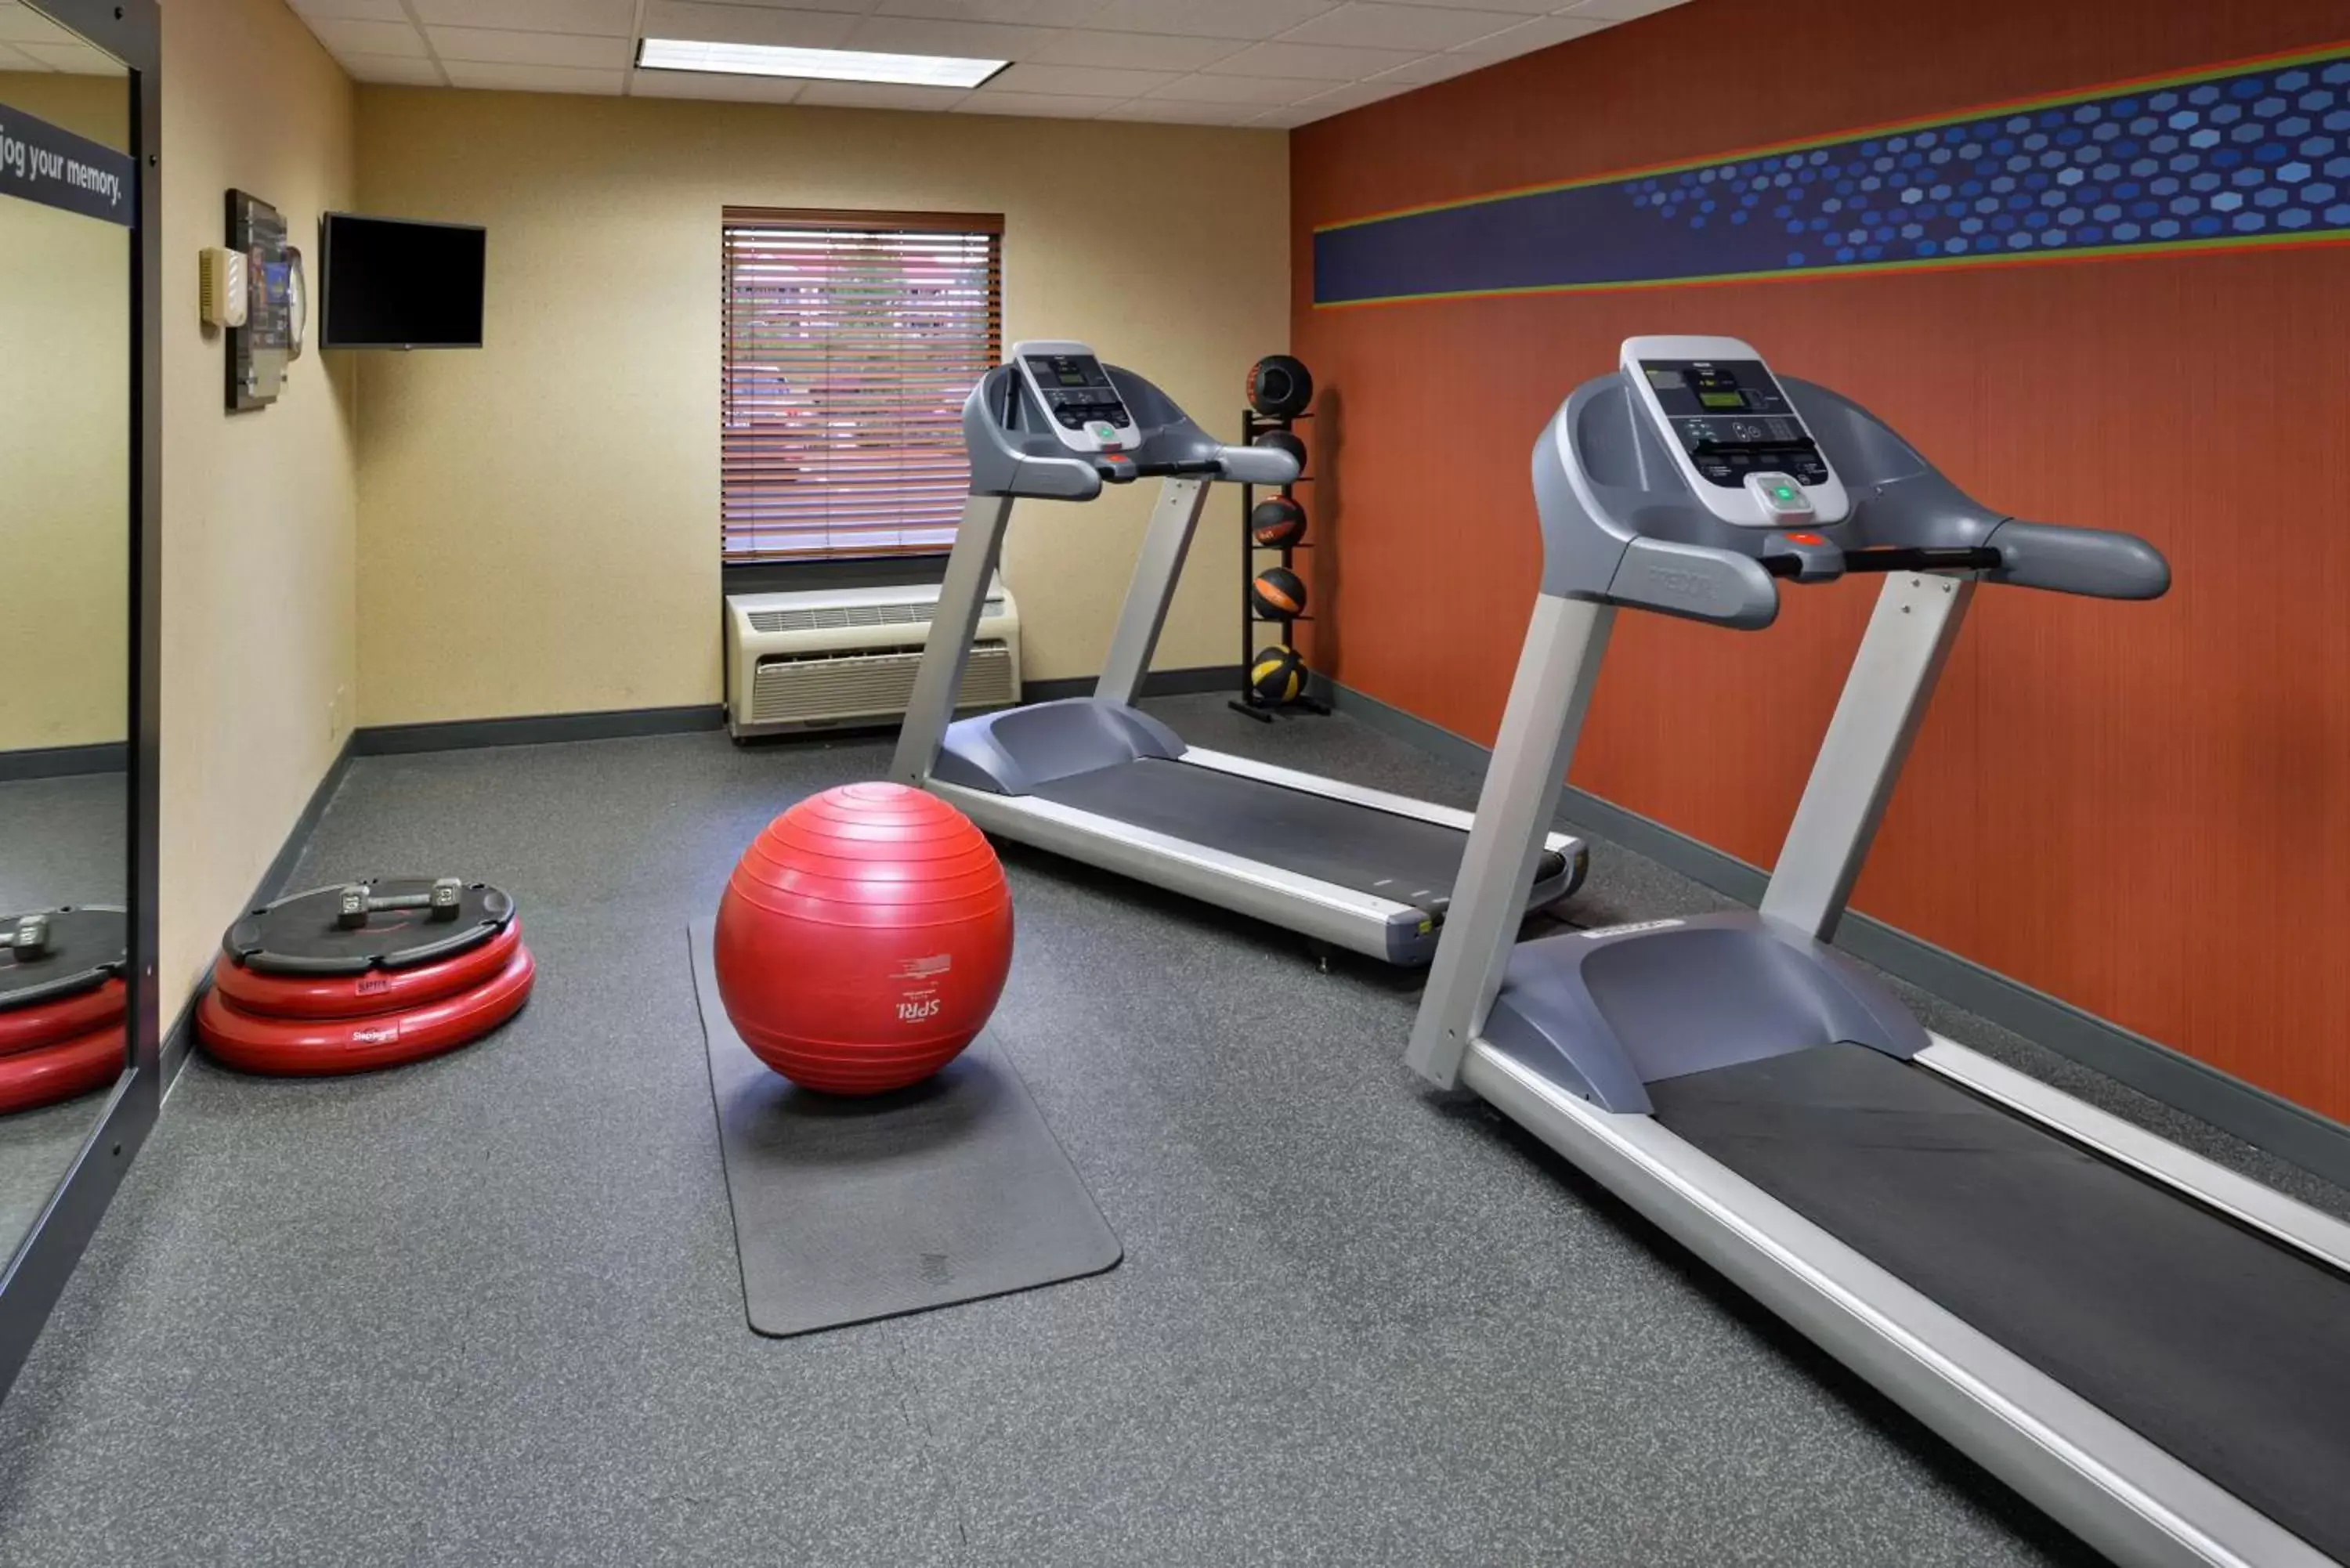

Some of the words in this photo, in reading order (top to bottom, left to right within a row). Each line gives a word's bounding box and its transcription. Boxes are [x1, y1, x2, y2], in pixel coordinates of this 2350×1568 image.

[29, 144, 64, 182] your
[67, 159, 121, 207] memory.
[898, 999, 941, 1019] SPRI
